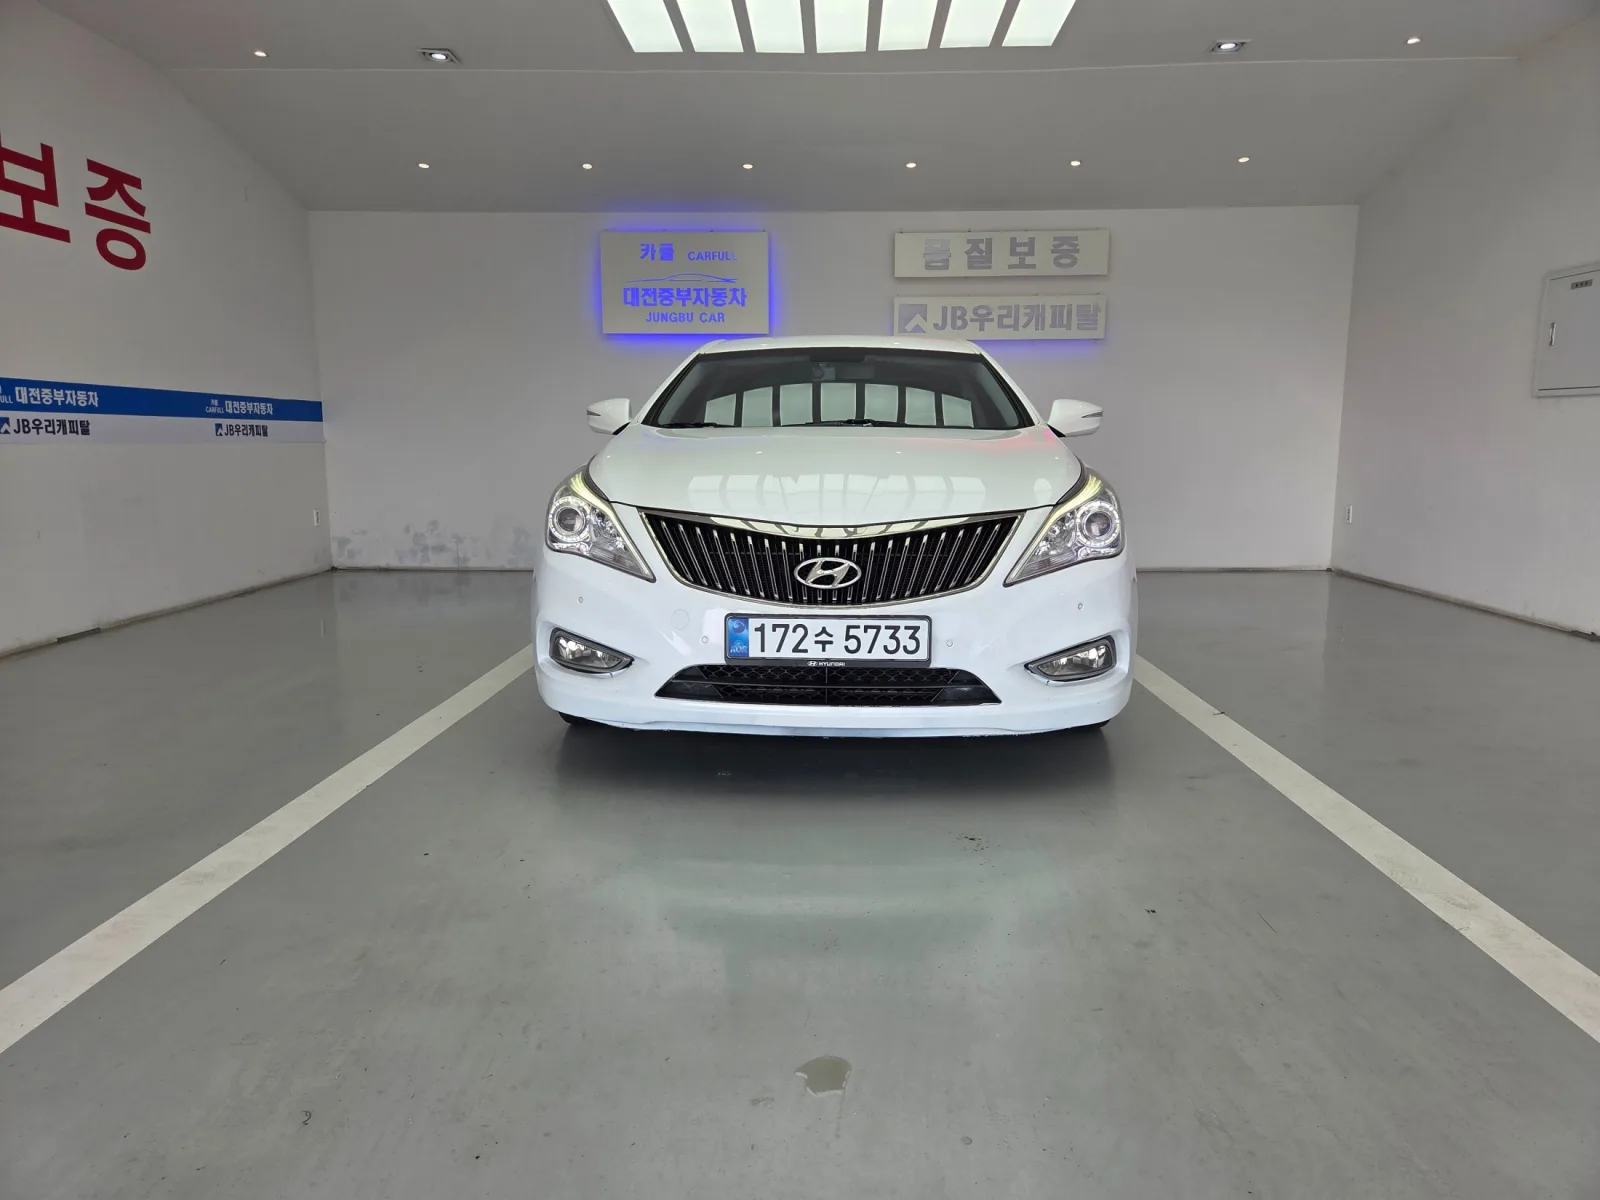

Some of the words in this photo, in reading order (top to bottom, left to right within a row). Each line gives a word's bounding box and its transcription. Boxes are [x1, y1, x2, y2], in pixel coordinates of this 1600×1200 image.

[688, 251, 737, 261] CARFULL
[623, 287, 747, 307] 대전중부자동차
[646, 312, 694, 323] JUNGBU
[699, 312, 725, 323] CAR
[933, 303, 1101, 331] JB우리캐피탈
[15, 386, 99, 407] 대전중부자동차
[225, 400, 273, 415] 대전중부자동차
[13, 418, 91, 435] JB우리캐피탈
[224, 424, 268, 437] JB우리캐피탈
[754, 623, 834, 653] 172수
[844, 625, 921, 655] 5733
